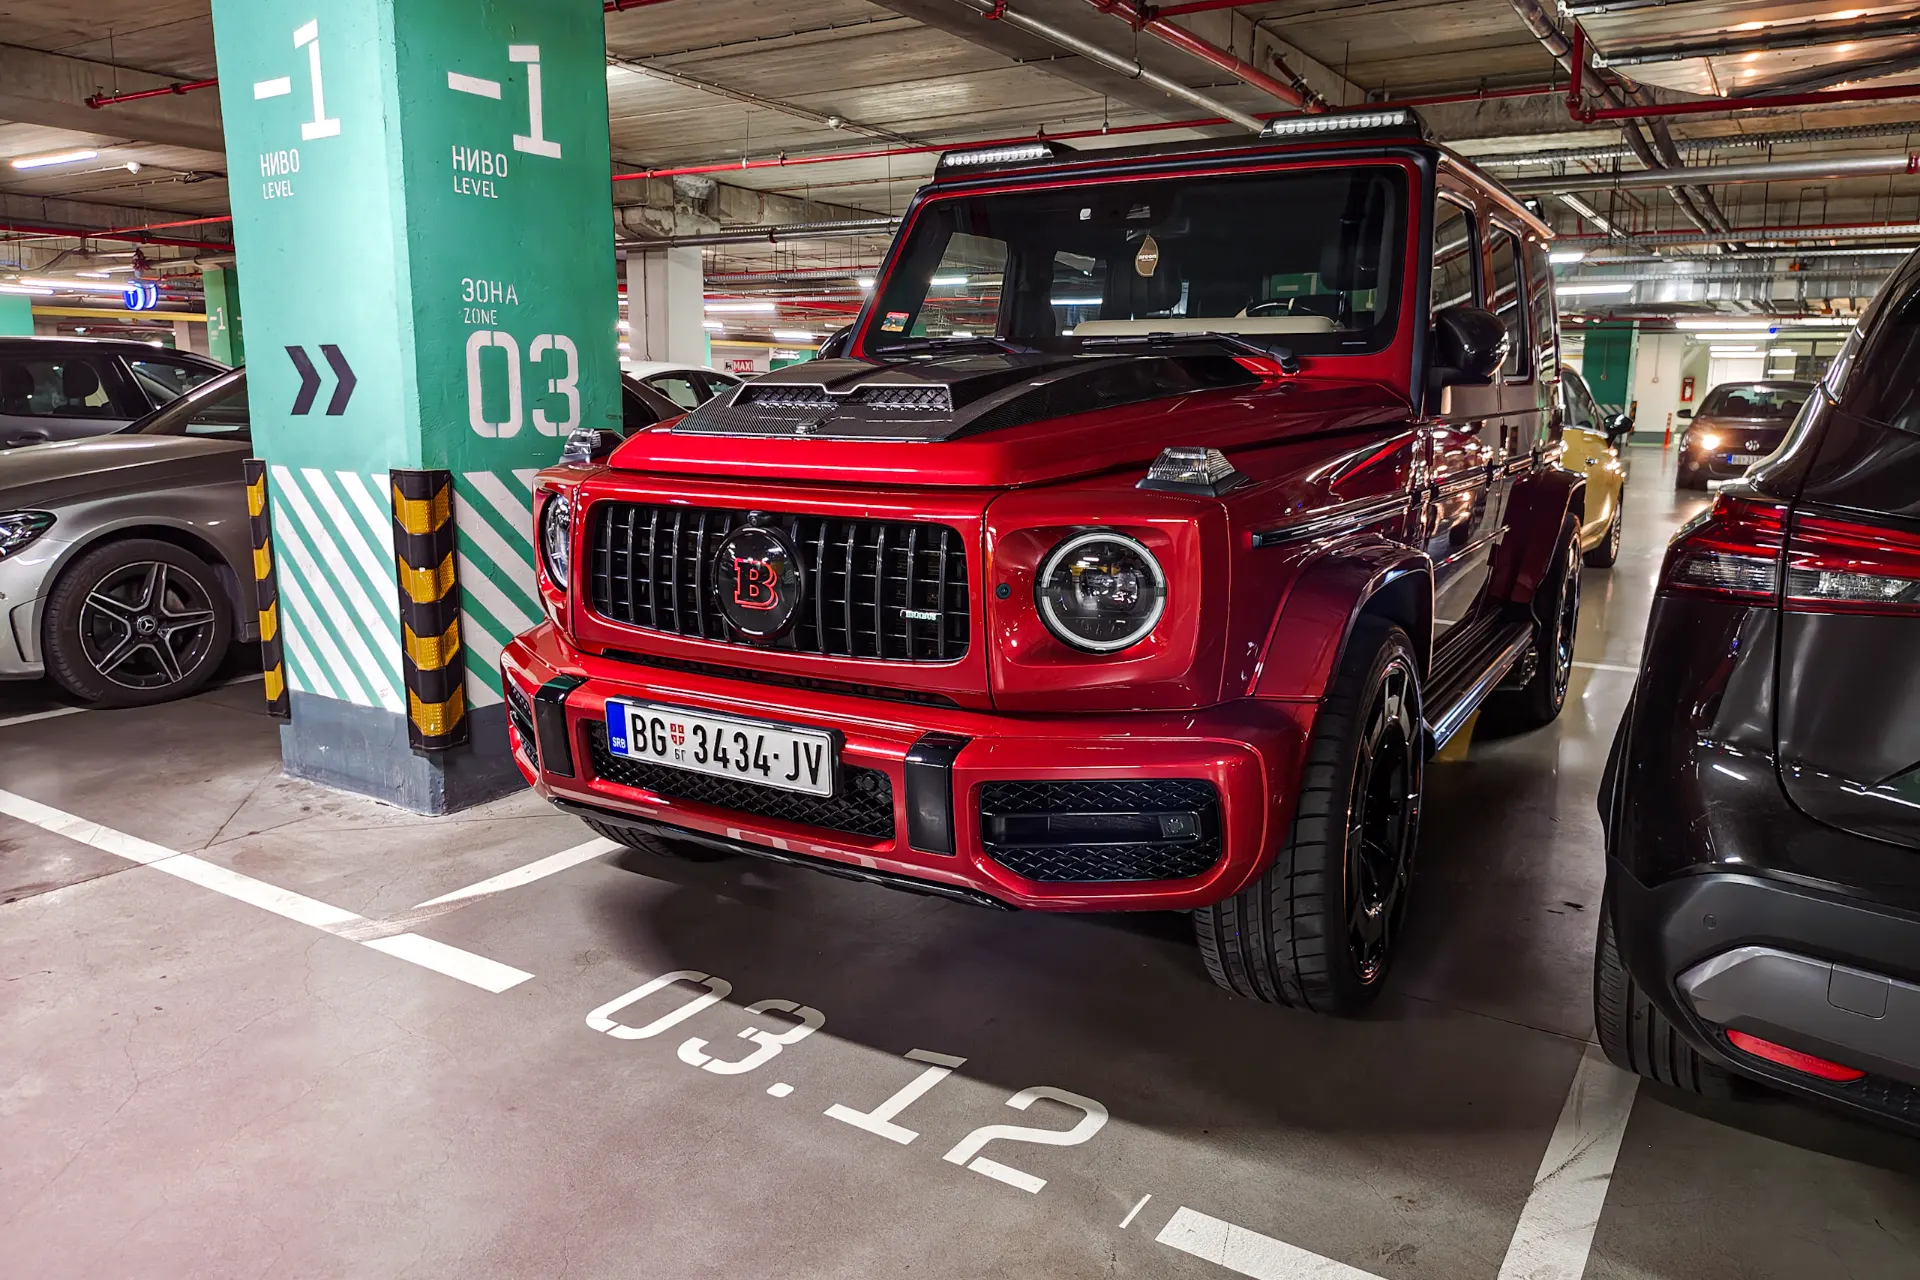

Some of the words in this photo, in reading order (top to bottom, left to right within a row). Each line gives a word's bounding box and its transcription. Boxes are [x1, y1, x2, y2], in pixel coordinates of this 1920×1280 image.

[253, 18, 340, 141] -1
[447, 45, 561, 159] -1
[260, 148, 300, 177] НИВО
[452, 145, 508, 178] НИВО
[263, 179, 295, 200] LEVEL
[453, 175, 499, 199] LEVEL
[461, 277, 519, 306] ЗОНА
[464, 307, 499, 326] ZONE
[733, 361, 753, 371] MAXI
[466, 330, 581, 438] 03
[734, 557, 779, 610] B
[612, 736, 626, 749] SRB
[630, 713, 667, 756] BG
[585, 970, 1109, 1194] 03.12
